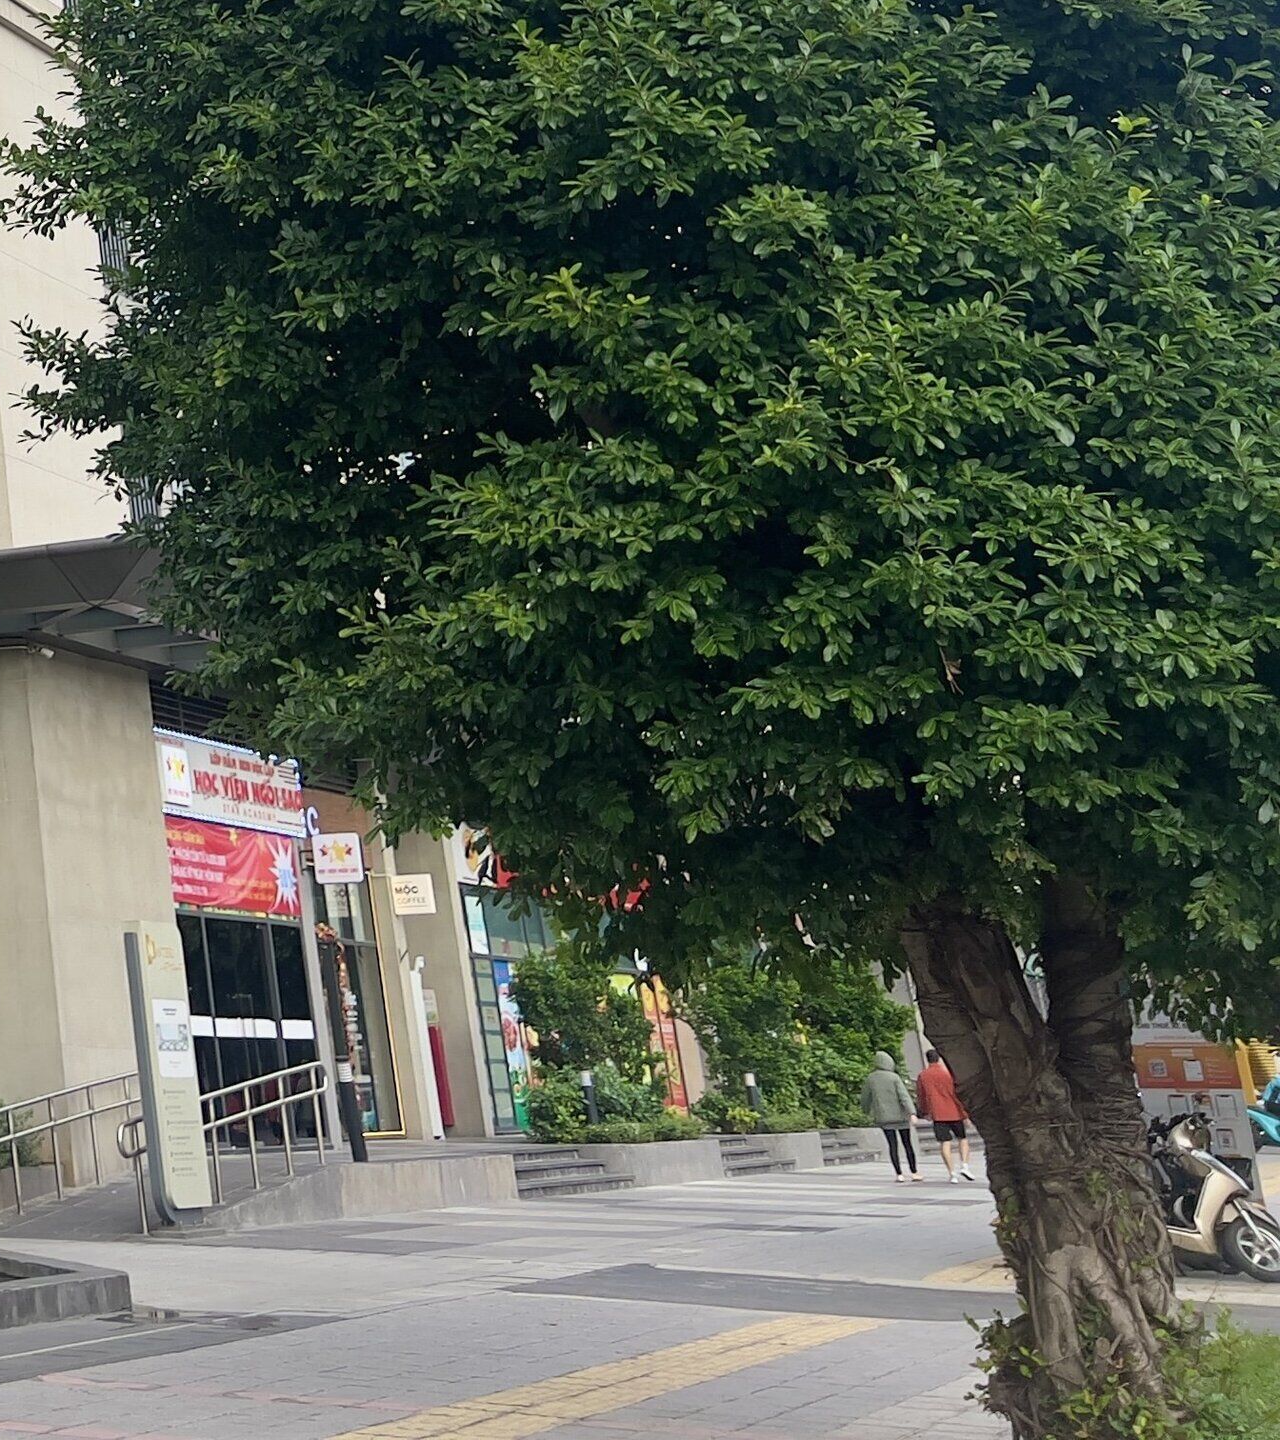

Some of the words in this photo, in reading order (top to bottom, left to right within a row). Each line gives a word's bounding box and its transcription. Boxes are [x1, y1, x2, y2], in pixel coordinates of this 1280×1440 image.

[193, 769, 219, 799] HỌC
[220, 772, 249, 804] VIỆN
[251, 780, 279, 808] NGÔI
